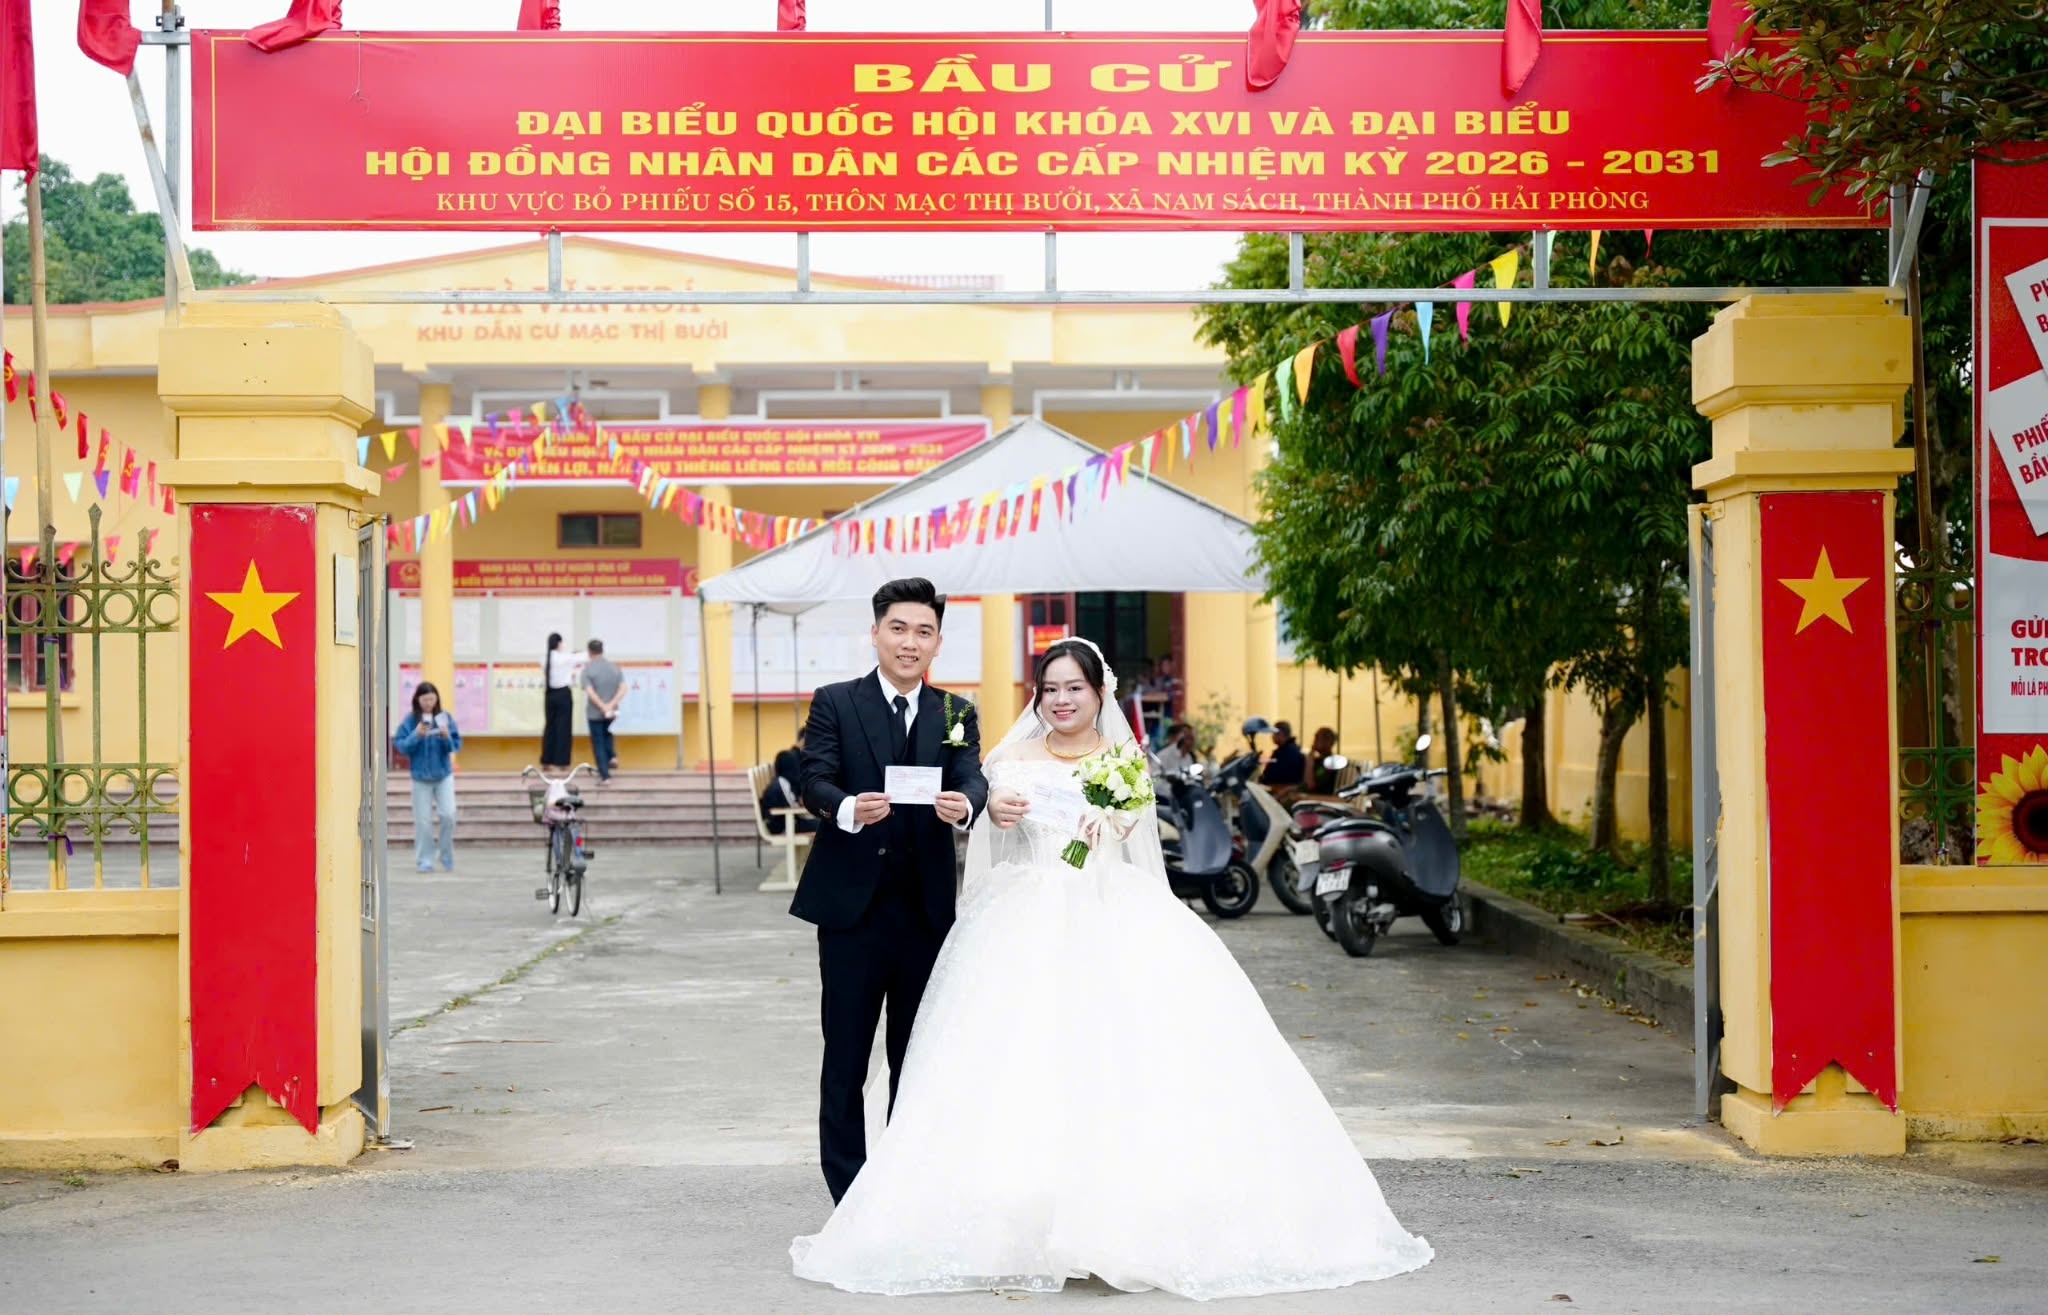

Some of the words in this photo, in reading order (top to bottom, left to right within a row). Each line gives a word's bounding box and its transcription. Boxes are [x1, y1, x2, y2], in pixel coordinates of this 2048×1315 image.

[854, 54, 1052, 93] BẦU
[1089, 53, 1233, 93] CỬ
[516, 110, 602, 141] ĐẠI
[621, 101, 737, 136] BIỂU
[756, 103, 893, 138] QUỐC
[912, 106, 996, 141] HỘI
[1015, 105, 1153, 136] KHÓA
[1169, 111, 1252, 136] XVI
[1267, 105, 1335, 136] VÀ
[1349, 110, 1436, 141] ĐẠI
[1454, 101, 1570, 135] BIỂU
[365, 146, 450, 181] HỘI
[467, 143, 611, 176] ĐỒNG
[629, 147, 773, 176] NHÂN
[792, 147, 898, 176] DÂN
[916, 146, 1019, 176] CÁC
[1037, 142, 1140, 176] CẤP
[1156, 146, 1325, 181] NHIỆM
[1344, 146, 1409, 176] KỲ
[1425, 151, 1549, 175] 2026
[1603, 150, 1718, 174] 2031
[436, 192, 498, 211] KHU
[505, 191, 564, 216] VỰC
[573, 185, 612, 211] BỎ
[620, 187, 710, 212] PHIẾU
[718, 185, 756, 211] SỐ
[765, 193, 800, 215] 15,
[806, 188, 887, 212] THÔN
[894, 193, 957, 216] MẠC
[963, 192, 1014, 216] THỊ
[1023, 186, 1101, 215] BƯỞI,
[1106, 188, 1145, 211] XÃ
[1152, 193, 1215, 211] NAM
[1221, 188, 1305, 214] SÁCH,
[1313, 188, 1413, 211] THÀNH
[1422, 185, 1481, 211] PHỐ
[1490, 186, 1540, 210] HẢI
[1549, 187, 1650, 210] PHÒNG
[417, 325, 464, 342] KHU
[474, 319, 523, 341] DÂN
